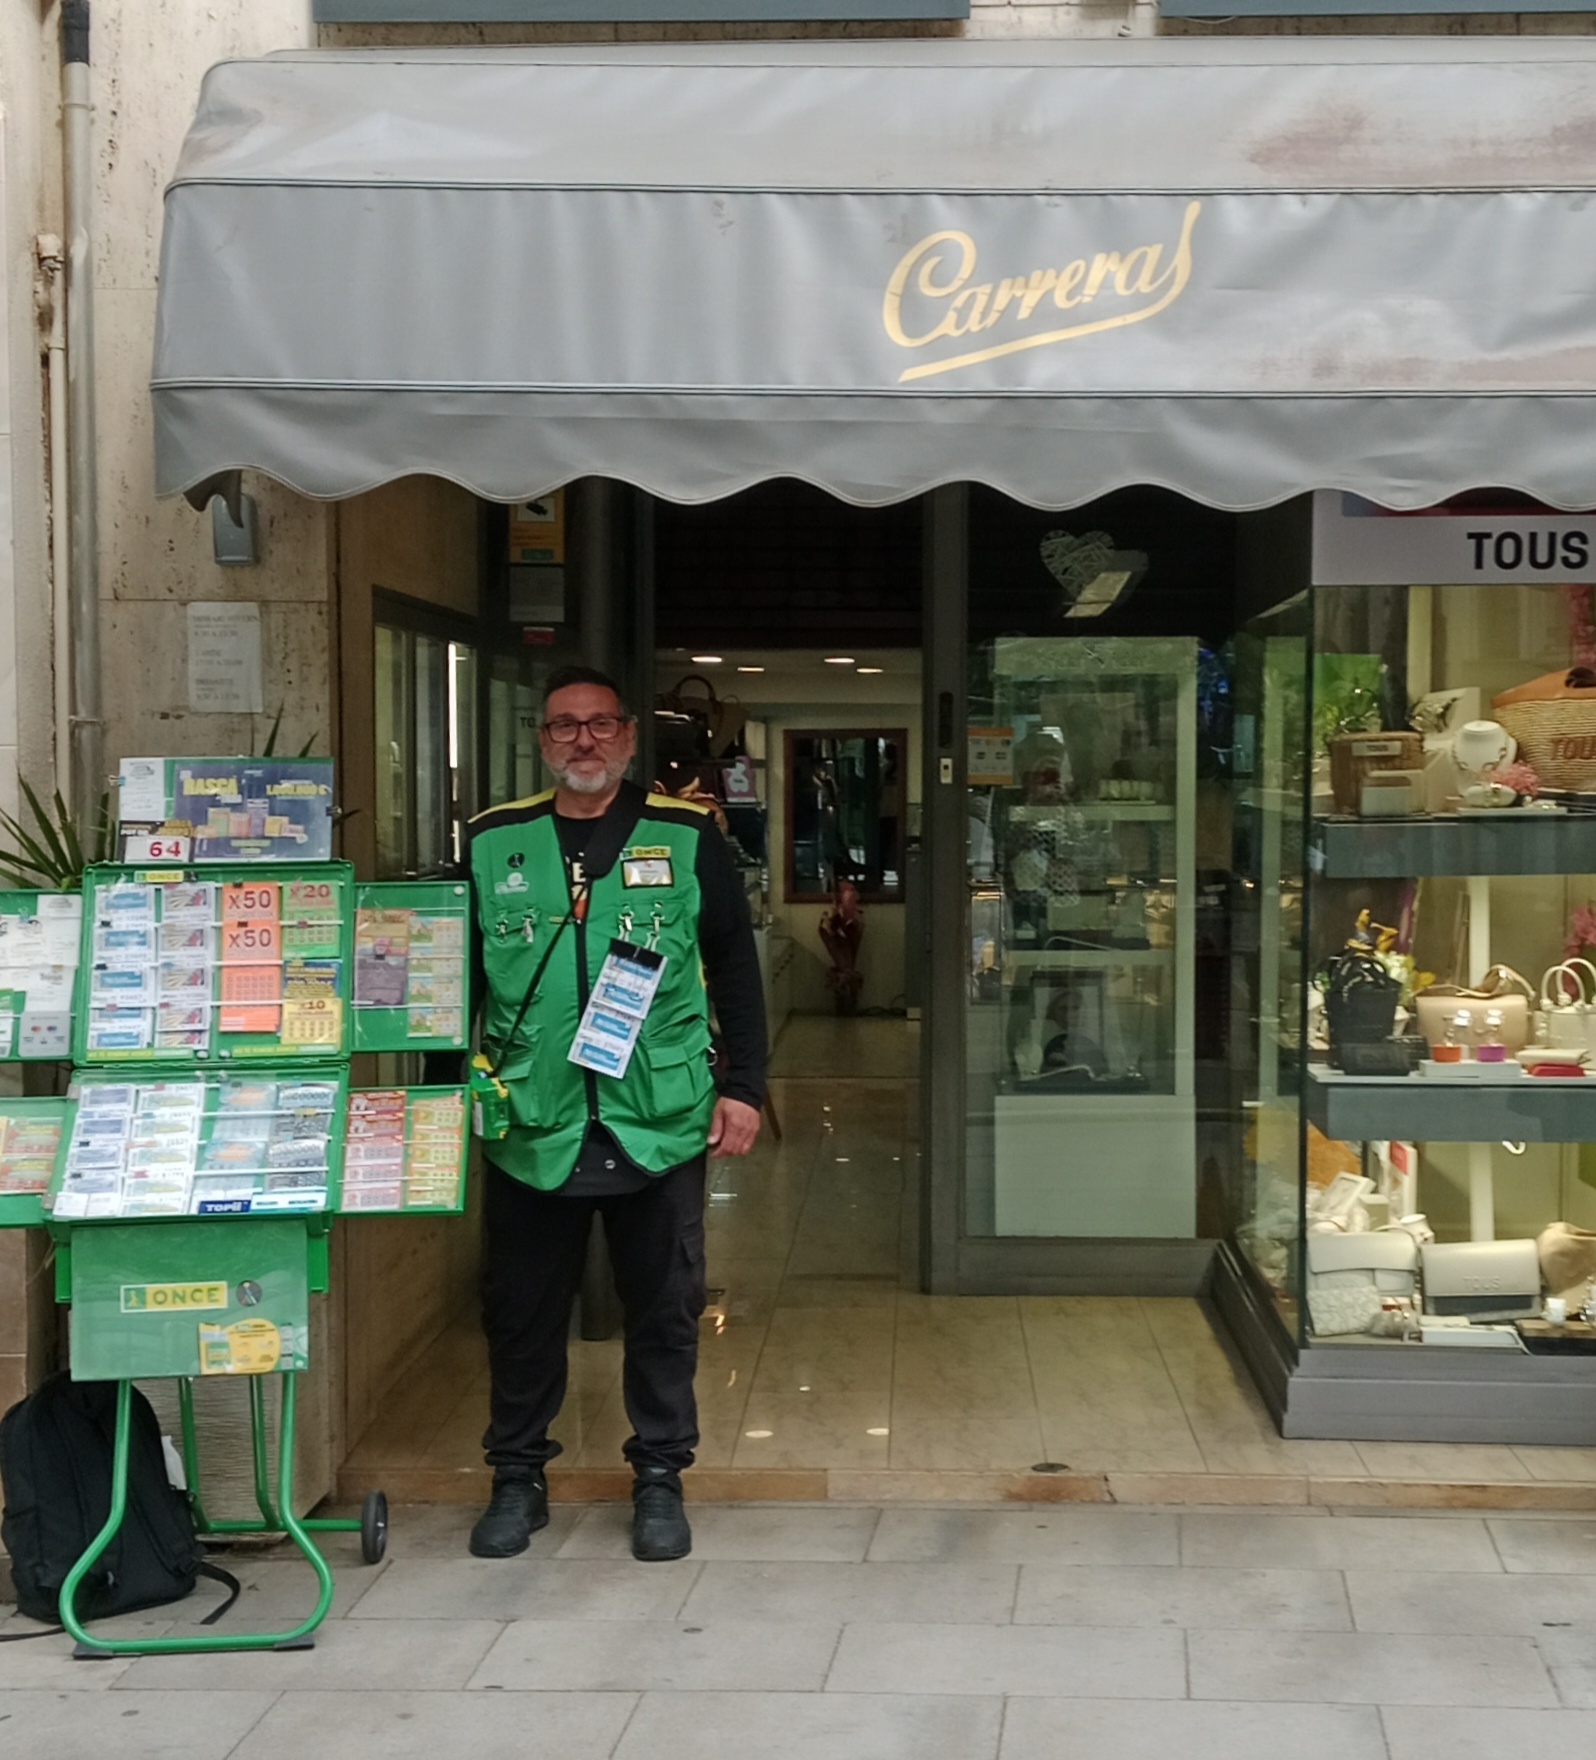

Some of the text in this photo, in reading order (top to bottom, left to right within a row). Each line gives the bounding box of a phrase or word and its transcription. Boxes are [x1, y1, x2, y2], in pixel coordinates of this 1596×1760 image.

[883, 201, 1201, 347] Carreras
[1466, 530, 1590, 571] TOUS
[150, 841, 181, 858] 64
[635, 848, 668, 857] ONCE
[153, 1287, 220, 1306] ONCE
